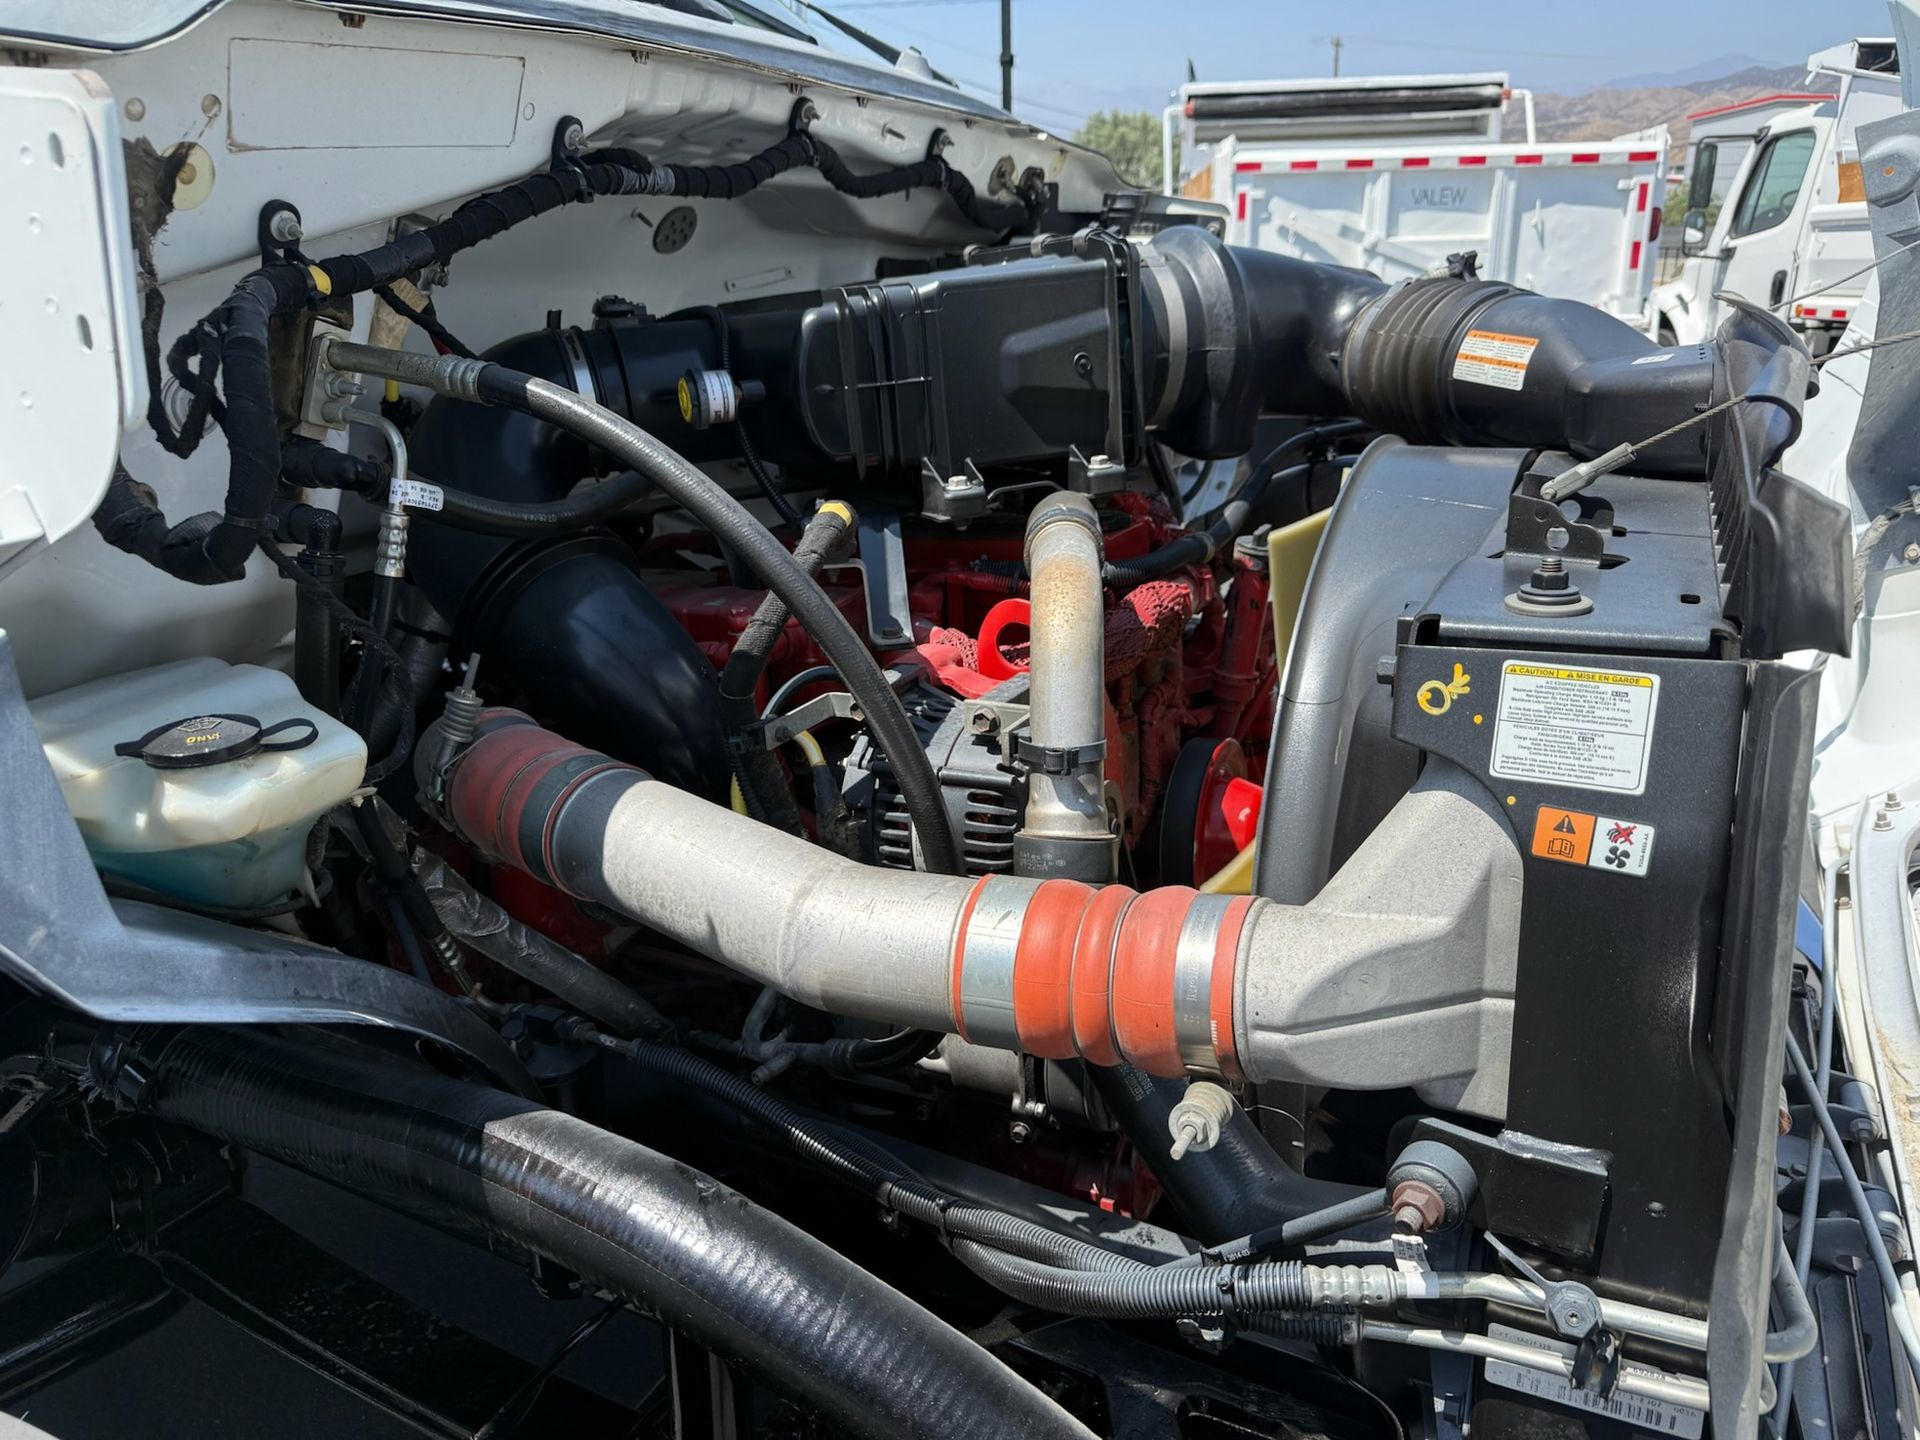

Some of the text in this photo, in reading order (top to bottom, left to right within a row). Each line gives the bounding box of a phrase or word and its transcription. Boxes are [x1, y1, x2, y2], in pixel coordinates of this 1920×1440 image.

[1412, 188, 1466, 206] VALEW
[1519, 668, 1554, 676] CAUTION
[1576, 673, 1597, 681] MISE
[1612, 676, 1640, 684] GARDE
